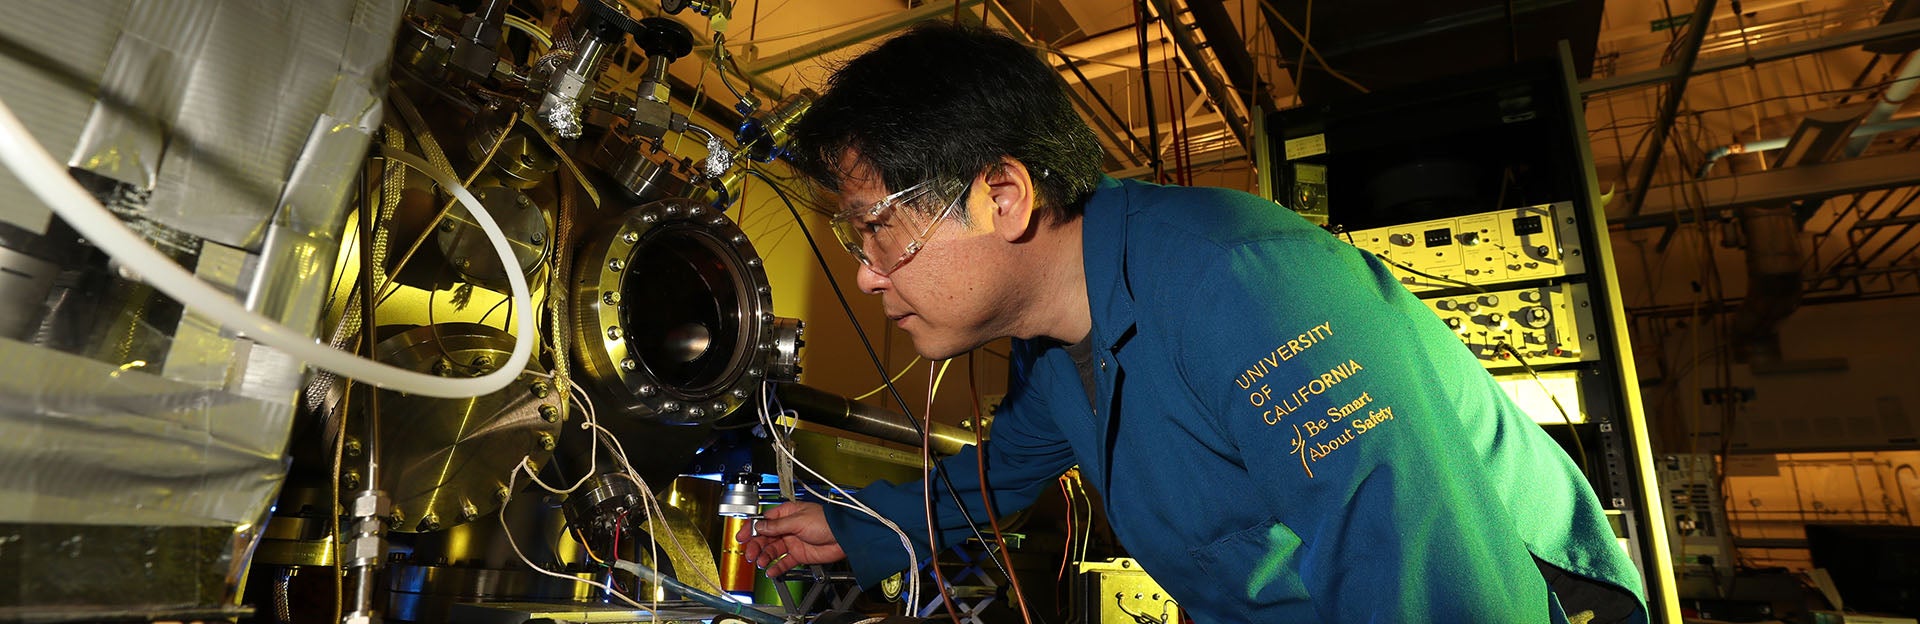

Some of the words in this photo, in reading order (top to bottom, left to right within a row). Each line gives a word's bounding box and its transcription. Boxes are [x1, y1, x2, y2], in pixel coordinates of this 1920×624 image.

[1235, 321, 1334, 390] UNIVERSITY
[1250, 384, 1272, 407] OF
[1263, 359, 1363, 425] CALIFORNIA
[1303, 420, 1329, 437] Be
[1327, 391, 1373, 423] Smart
[1309, 428, 1355, 462] About
[1352, 406, 1394, 435] Safety
